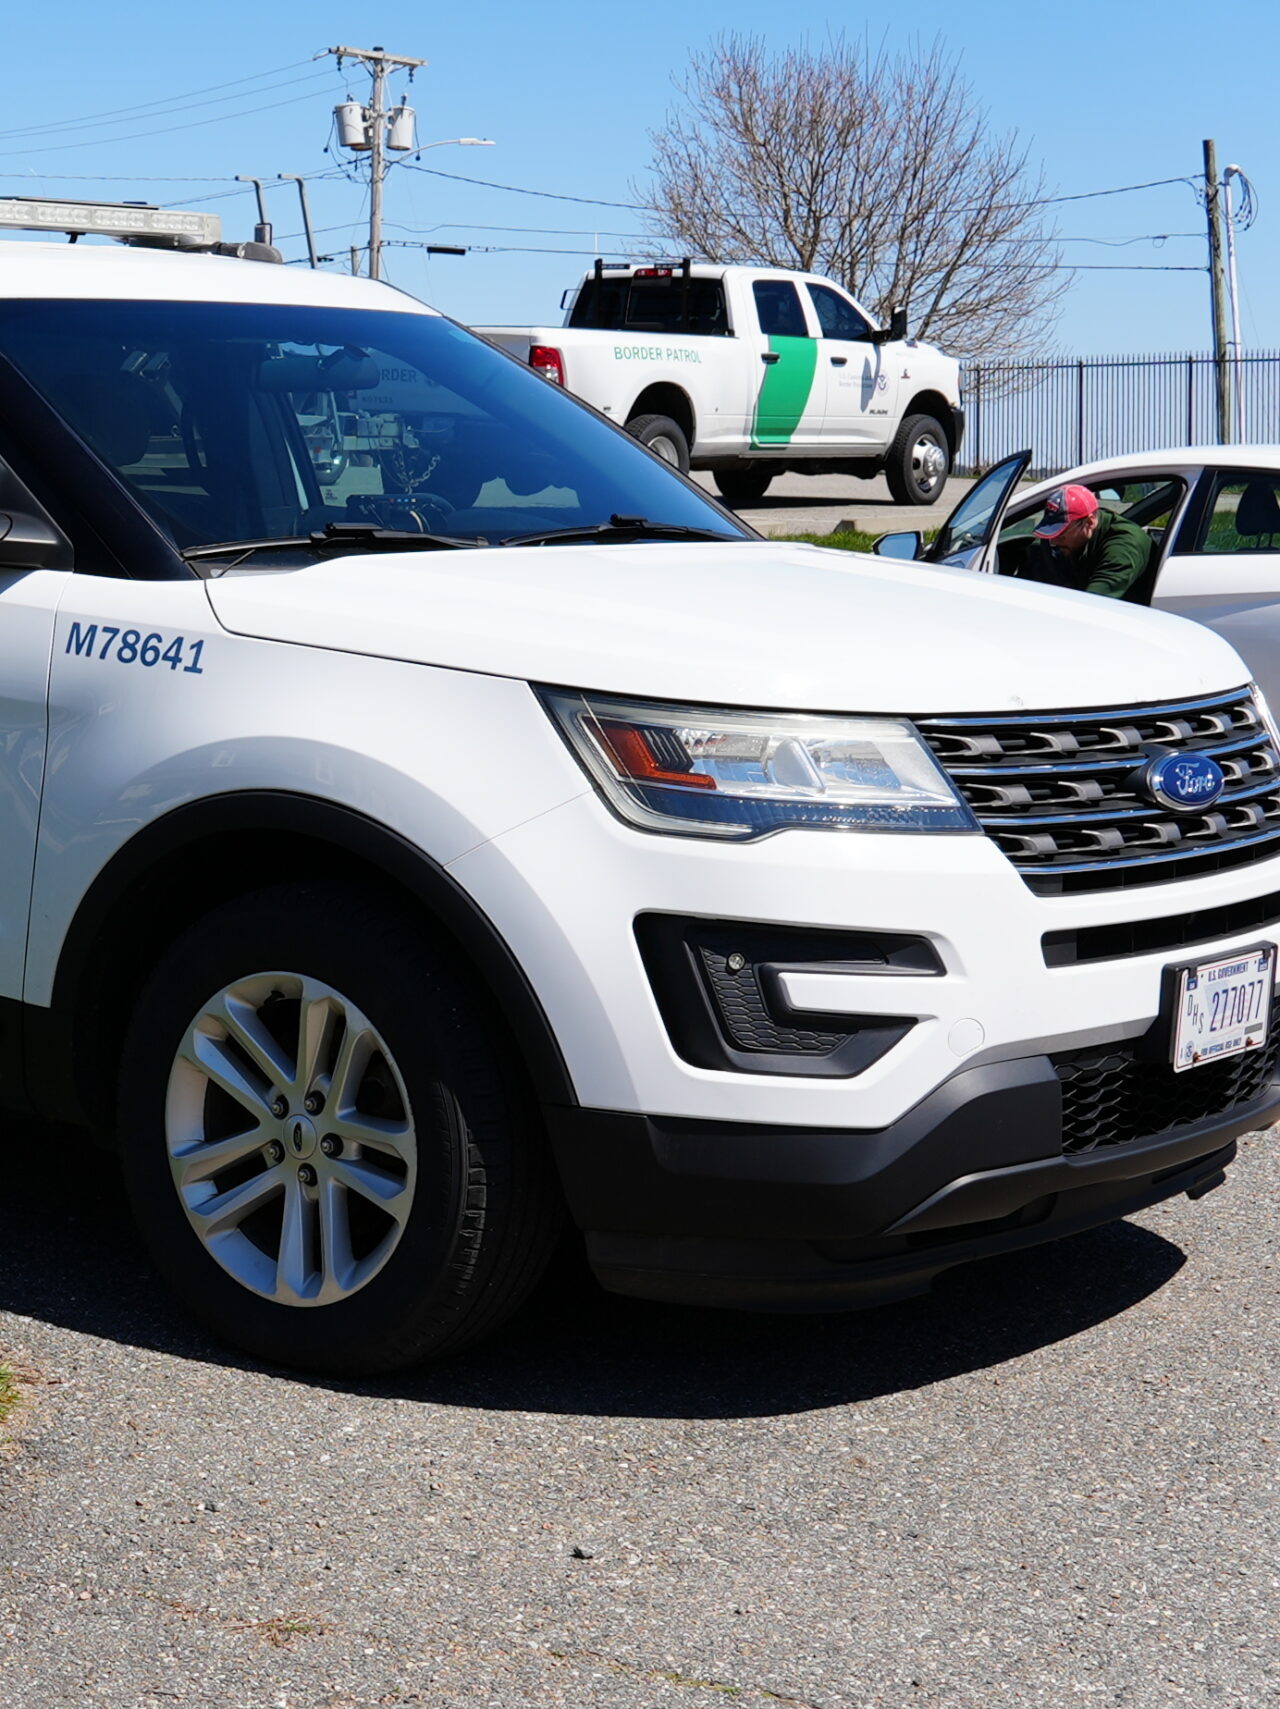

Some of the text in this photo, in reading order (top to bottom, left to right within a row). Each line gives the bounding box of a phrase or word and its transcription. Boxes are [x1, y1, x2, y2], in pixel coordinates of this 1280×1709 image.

[613, 346, 702, 364] BORDER PATROL
[381, 367, 417, 383] RDER
[65, 621, 205, 675] M78641
[1175, 762, 1216, 796] Ford
[1209, 979, 1264, 1033] 277077
